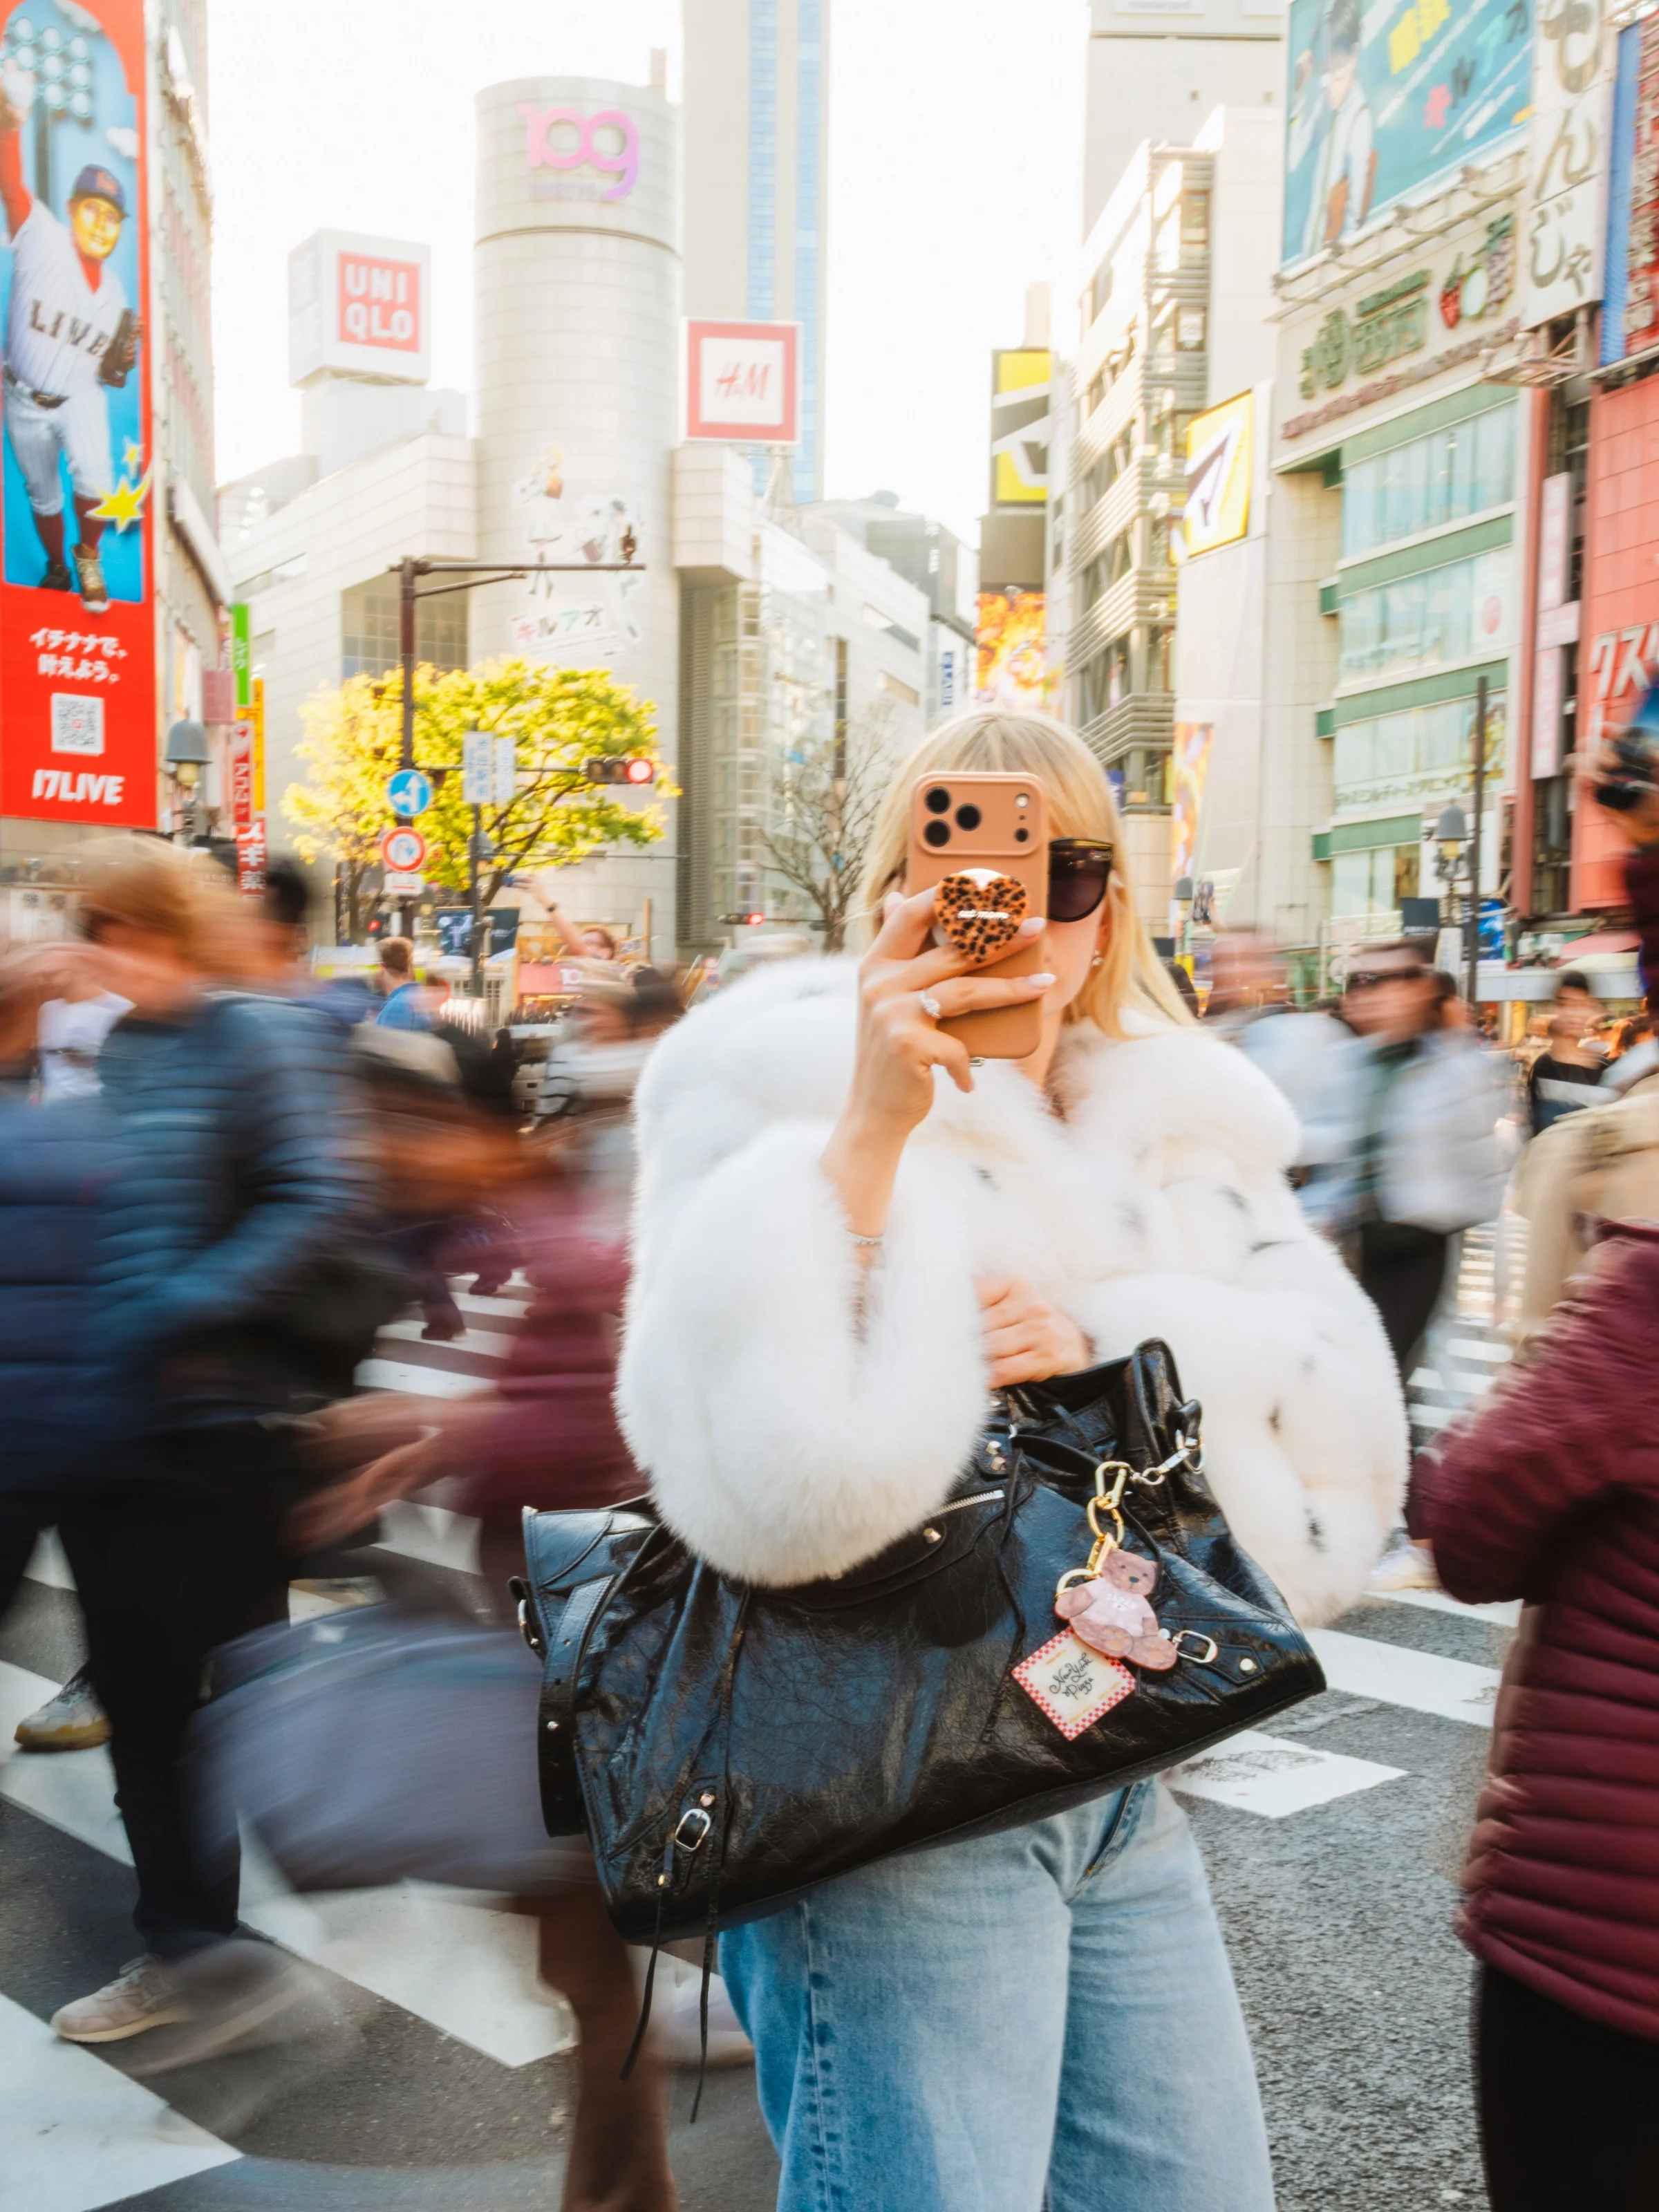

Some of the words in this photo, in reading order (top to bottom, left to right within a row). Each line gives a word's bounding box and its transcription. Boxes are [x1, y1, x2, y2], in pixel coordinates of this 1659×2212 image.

[516, 102, 640, 201] 109
[713, 361, 771, 401] H&M
[32, 769, 126, 806] 17LIVE
[236, 821, 267, 900] スギ薬
